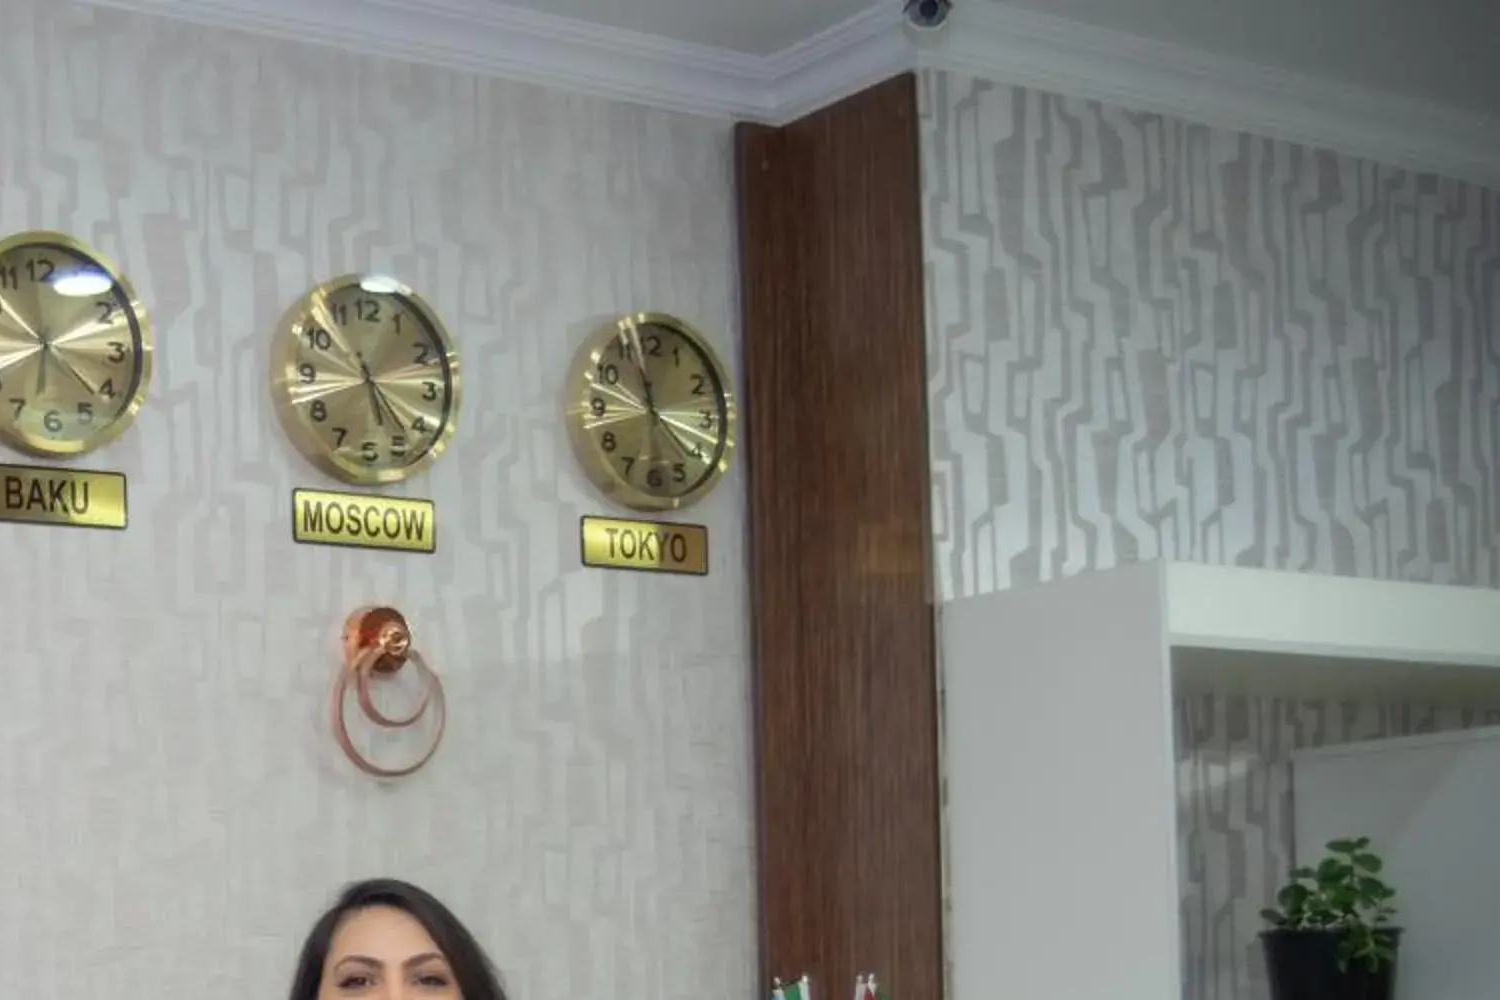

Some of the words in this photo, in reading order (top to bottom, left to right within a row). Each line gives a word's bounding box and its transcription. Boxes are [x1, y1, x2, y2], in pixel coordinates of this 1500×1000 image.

[96, 302, 113, 324] 2
[357, 298, 380, 322] 12
[306, 330, 331, 350] 10
[108, 342, 124, 363] 3
[413, 343, 428, 365] 2
[299, 364, 316, 384] 9
[690, 374, 705, 395] 2
[98, 379, 116, 398] 4
[422, 381, 436, 401] 3
[10, 398, 26, 420] 7
[76, 403, 92, 424] 5
[310, 401, 327, 422] 8
[591, 397, 606, 417] 9
[44, 410, 62, 432] 6
[412, 416, 427, 433] 4
[331, 427, 347, 447] 7
[601, 431, 616, 451] 8
[621, 456, 634, 474] 7
[672, 463, 686, 482] 5
[5, 476, 88, 514] BAKU
[303, 500, 425, 541] MOSCOW
[605, 528, 687, 563] TOKYO
